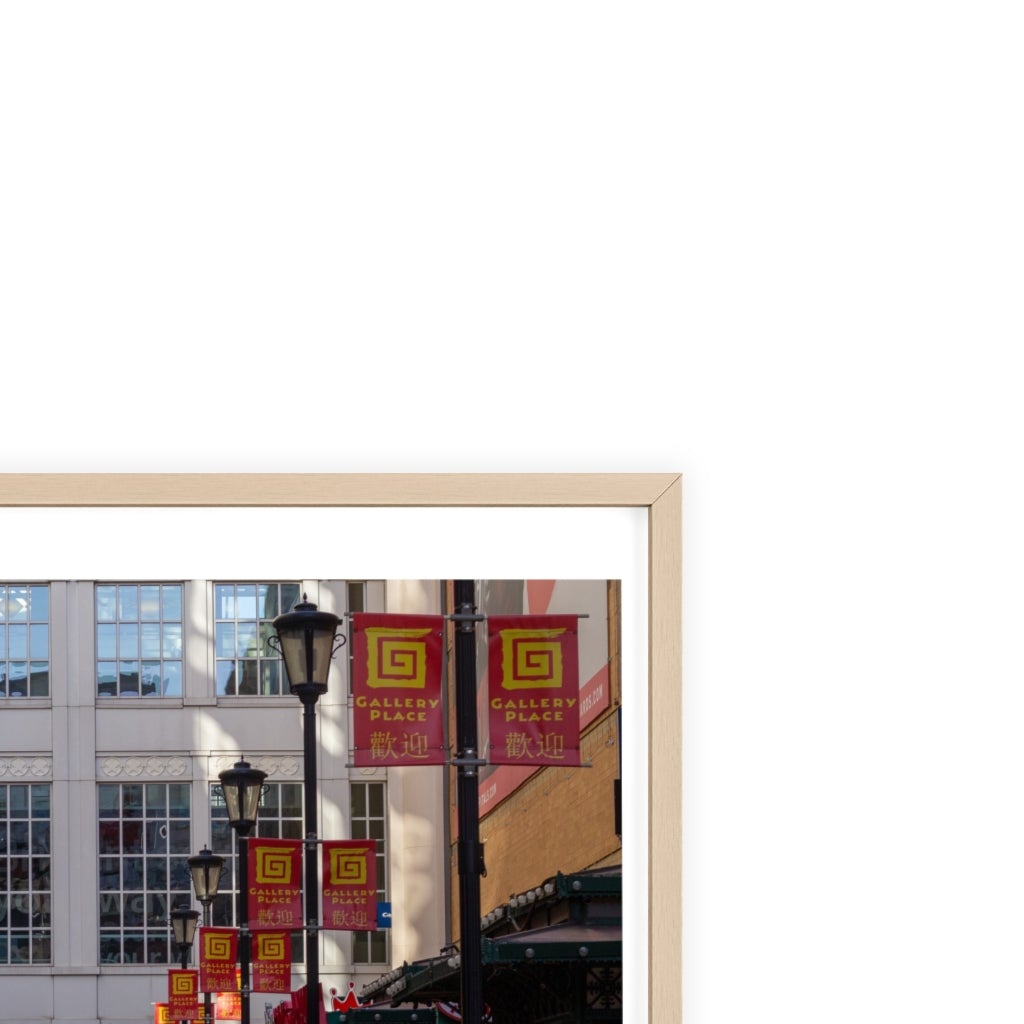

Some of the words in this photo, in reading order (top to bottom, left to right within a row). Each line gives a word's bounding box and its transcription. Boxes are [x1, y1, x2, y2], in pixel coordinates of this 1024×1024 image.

[356, 696, 440, 709] GALLERY
[491, 698, 577, 709] GALLERY
[370, 709, 427, 721] PLACE
[505, 711, 564, 722] PLACE
[370, 731, 430, 760] 歡迎
[505, 732, 565, 759] 歡迎
[249, 888, 299, 896] GALLERY
[323, 889, 376, 897] GALLERY
[258, 896, 292, 904] PLACE
[332, 897, 367, 905] PLACE
